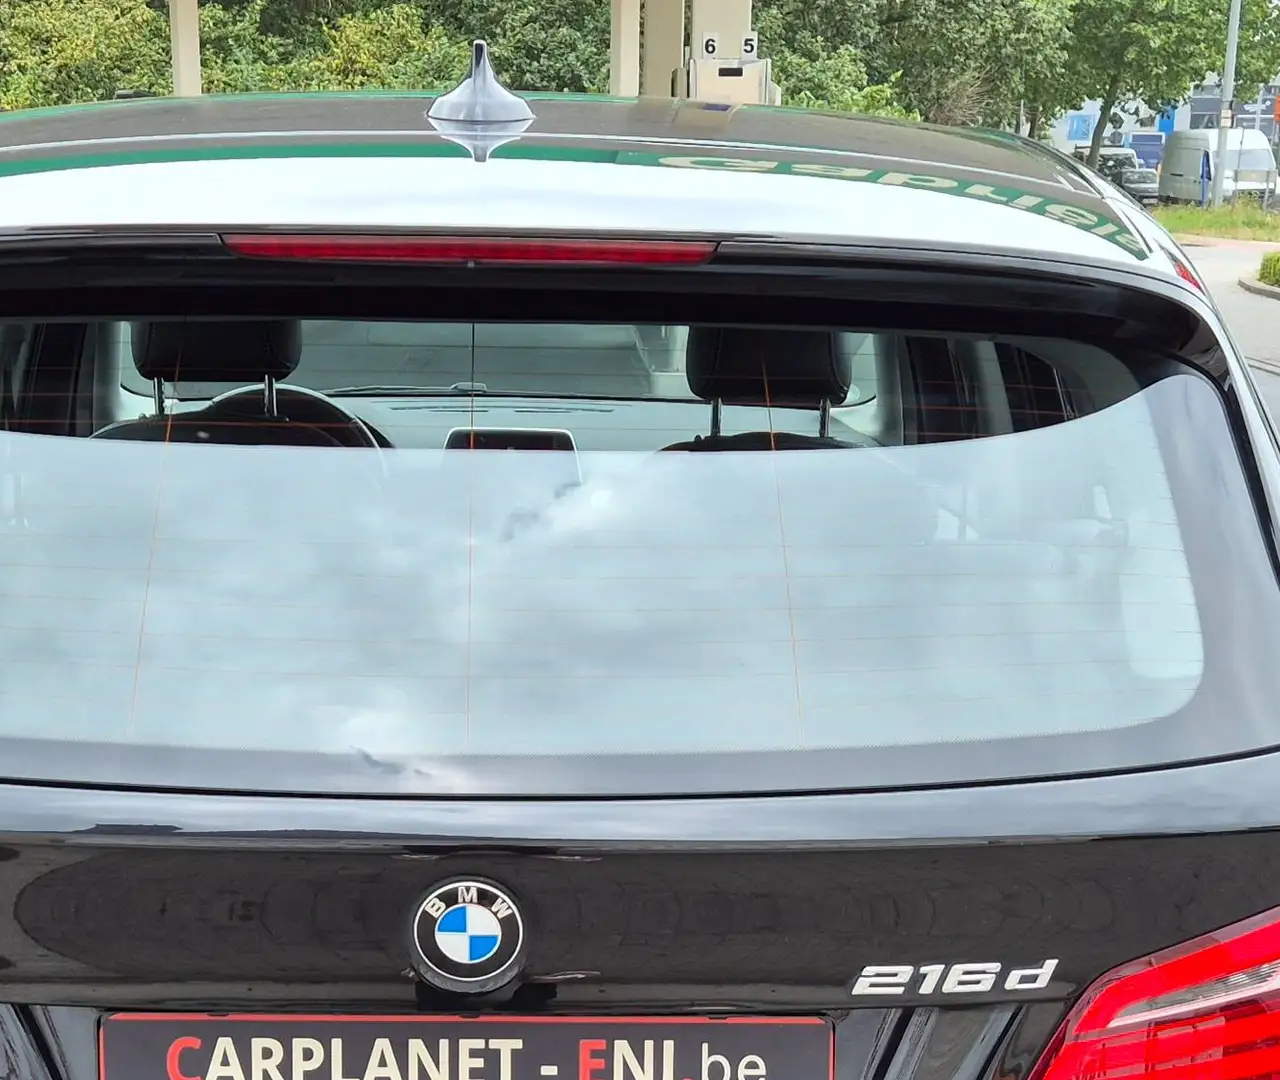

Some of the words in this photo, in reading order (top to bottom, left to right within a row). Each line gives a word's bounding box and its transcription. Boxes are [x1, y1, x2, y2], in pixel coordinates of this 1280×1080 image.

[704, 38, 716, 54] 6
[743, 38, 755, 53] 5
[424, 886, 514, 919] BMW
[540, 1064, 558, 1077] -
